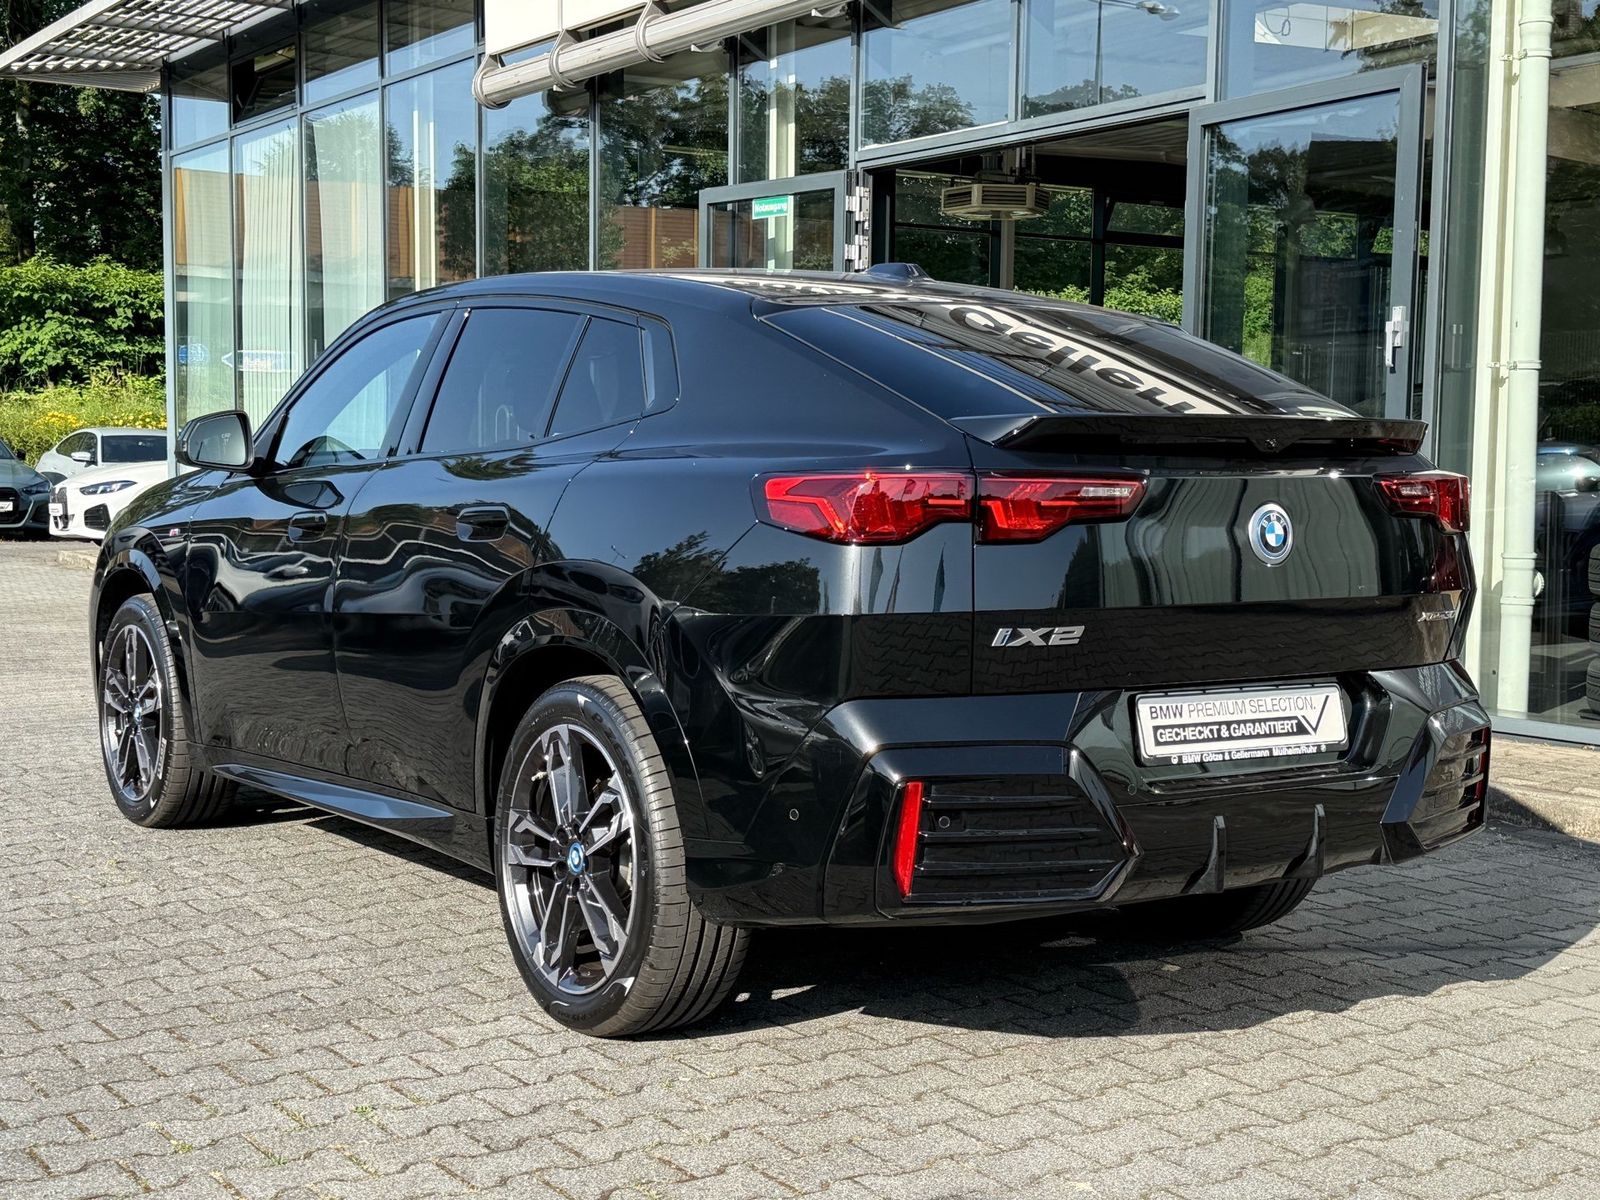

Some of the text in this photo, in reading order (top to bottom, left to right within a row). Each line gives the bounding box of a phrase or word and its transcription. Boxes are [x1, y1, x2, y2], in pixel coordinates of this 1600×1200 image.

[991, 625, 1085, 647] iX2
[1149, 696, 1317, 720] BMW PREMIUM SELECTION.
[1156, 719, 1299, 743] GECHECKT & GARANTIERT
[1182, 754, 1201, 764] BMW
[1224, 752, 1230, 761] &
[1231, 749, 1270, 760] Gellermann
